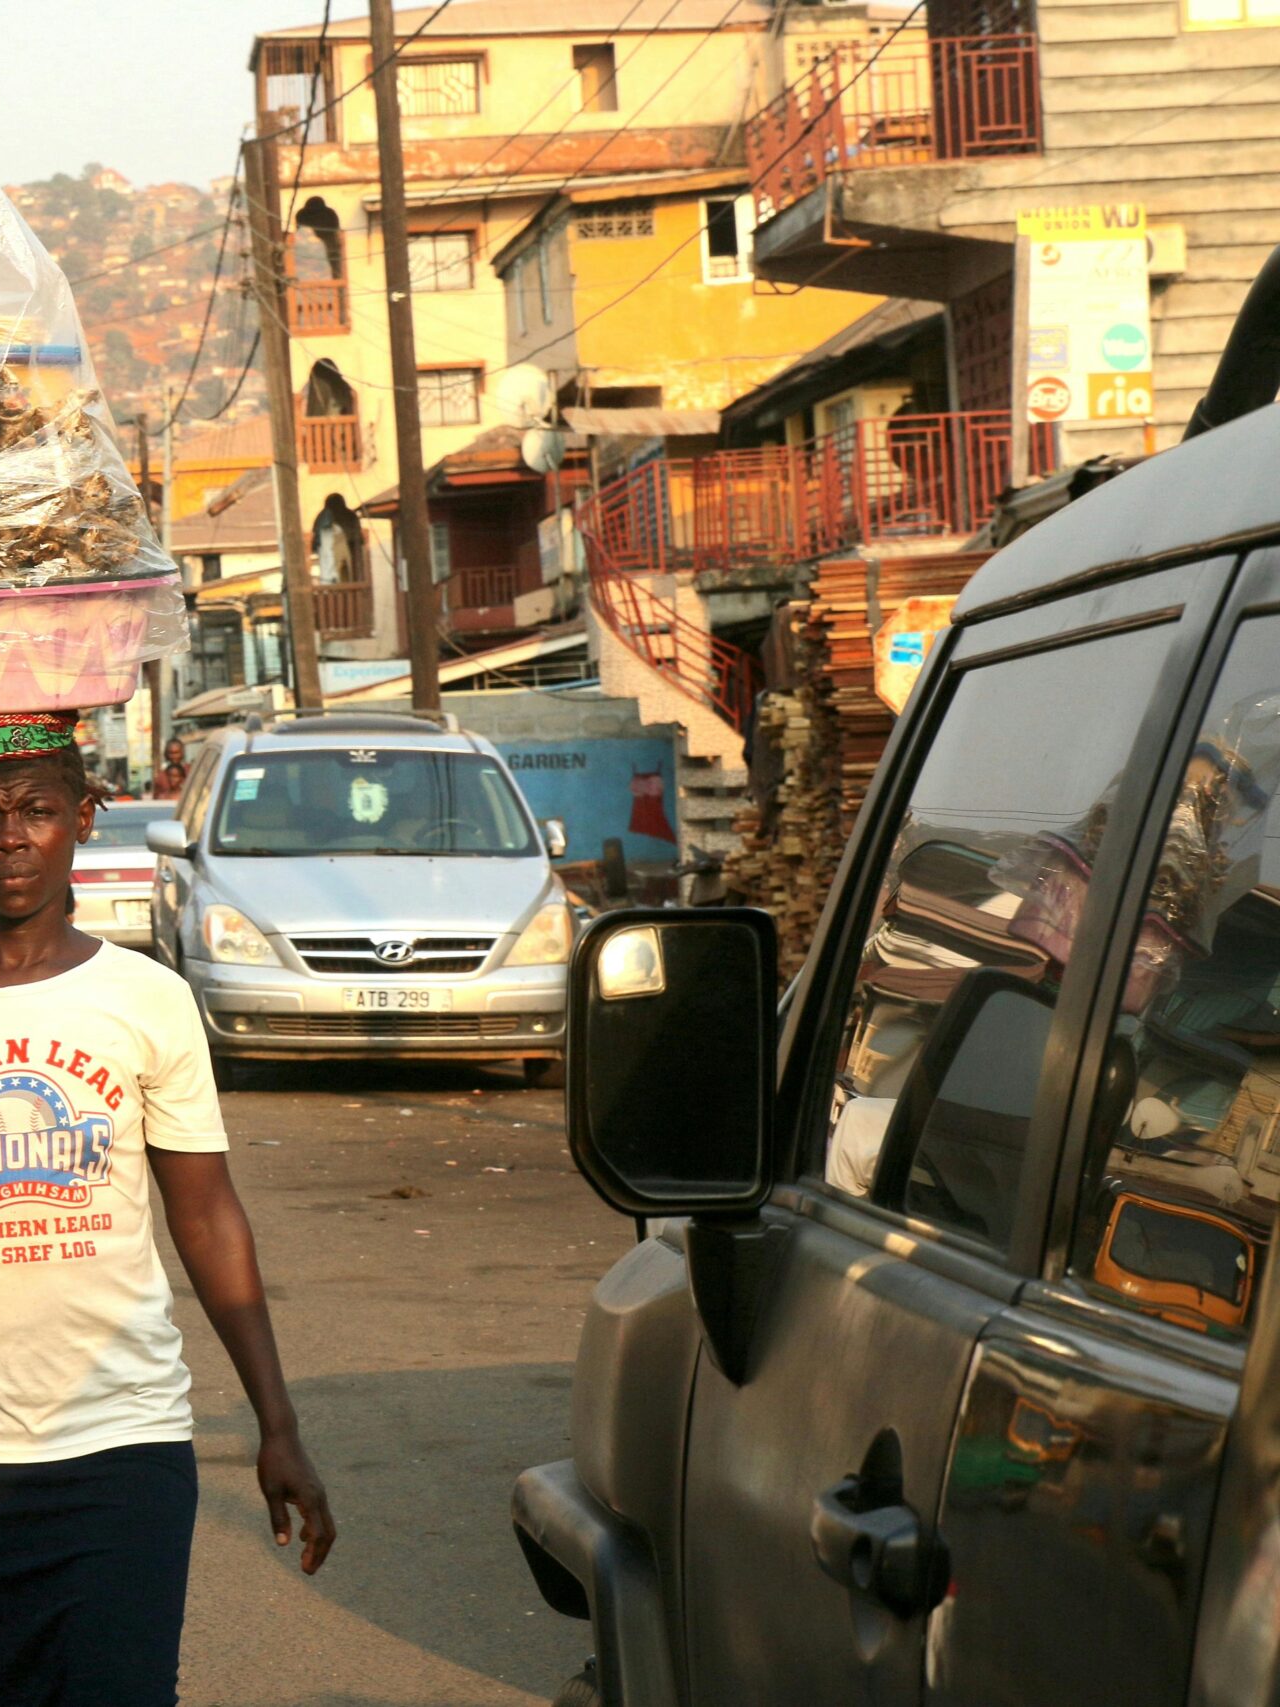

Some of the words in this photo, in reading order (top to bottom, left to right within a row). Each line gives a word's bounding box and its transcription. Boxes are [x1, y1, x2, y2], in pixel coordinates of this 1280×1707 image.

[1097, 375, 1152, 416] ria
[507, 752, 587, 770] GARDEN
[356, 991, 389, 1008] ATB
[398, 991, 429, 1008] 299
[46, 1039, 124, 1111] LEAG
[54, 1213, 113, 1235] LEAGD
[1, 1244, 54, 1265] SREF
[60, 1240, 97, 1260] LOG
